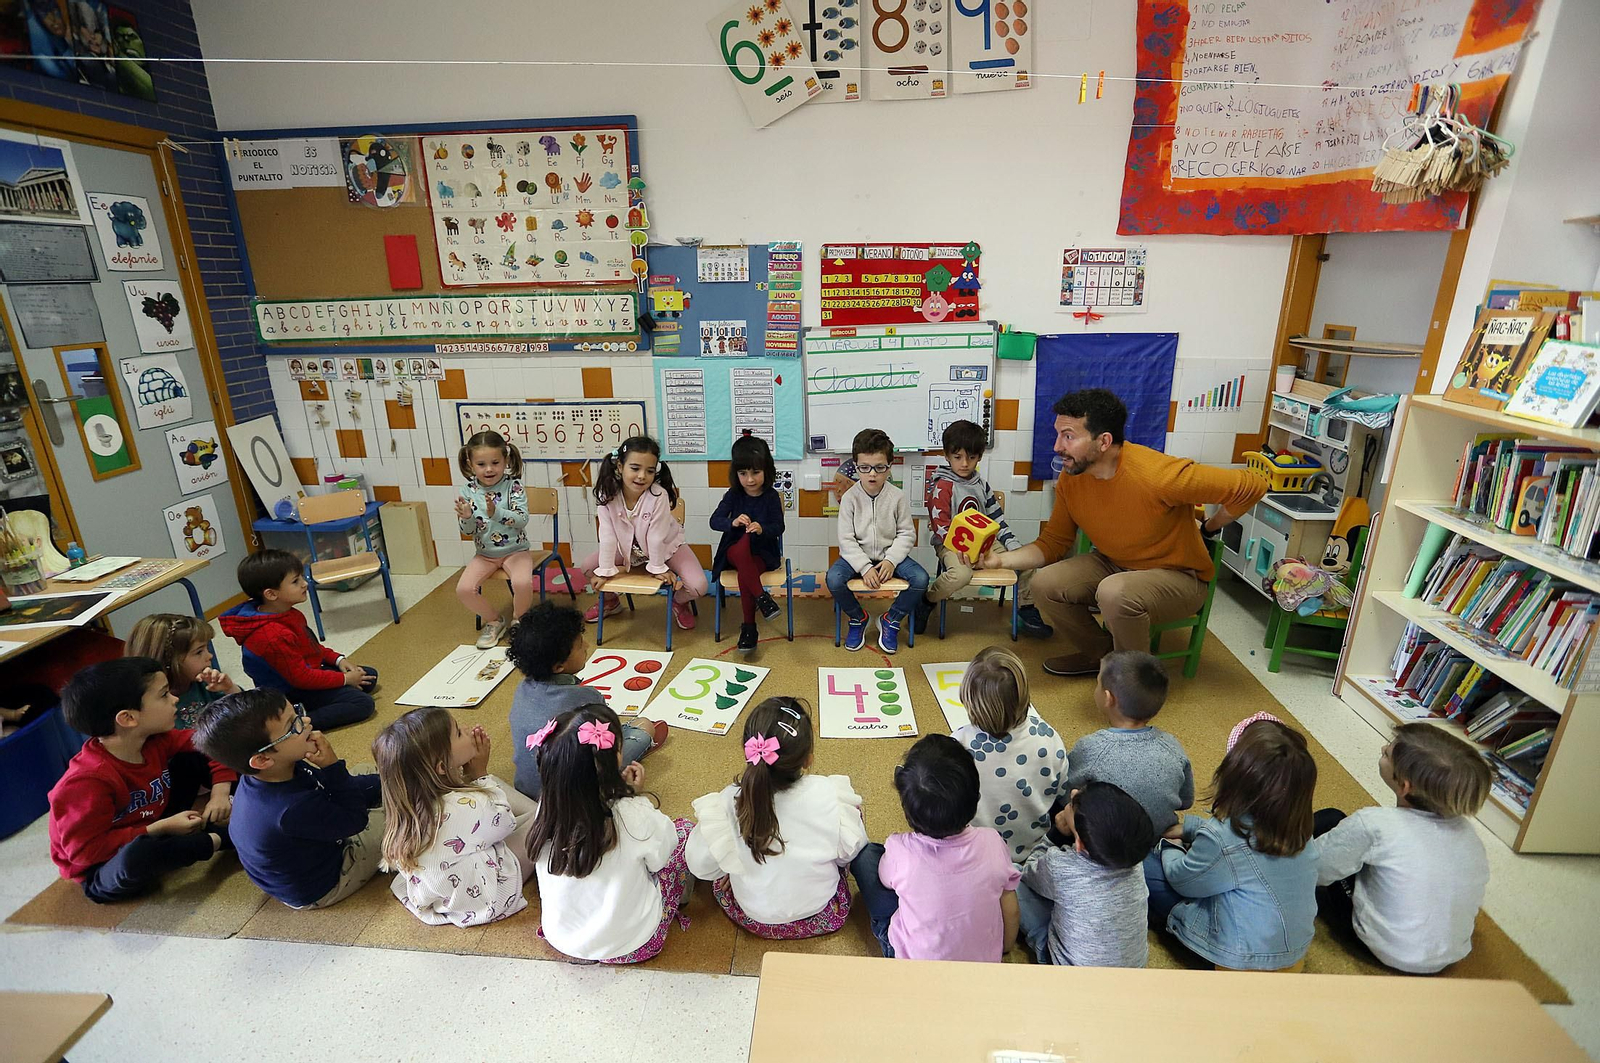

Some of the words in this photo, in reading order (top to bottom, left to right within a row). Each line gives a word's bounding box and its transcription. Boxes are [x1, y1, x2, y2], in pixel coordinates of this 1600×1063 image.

[1194, 5, 1198, 14] 1
[1201, 4, 1215, 14] NO
[872, 0, 910, 53] 8
[956, 0, 991, 50] 9
[1191, 21, 1196, 30] 2
[720, 20, 766, 84] 6
[896, 77, 919, 88] ocho
[776, 88, 794, 103] seis
[1176, 126, 1180, 134] 8
[1185, 128, 1200, 137] NO
[304, 147, 317, 158] ES
[1174, 144, 1178, 153] 9
[1185, 141, 1217, 158] NO
[1312, 162, 1319, 170] 20
[238, 174, 282, 182] PUNTALITO
[112, 252, 158, 268] elefante
[866, 249, 892, 259] VERANO
[902, 249, 924, 260] OTOÑO
[128, 285, 147, 296] Uu
[156, 339, 180, 348] uvas
[888, 338, 896, 347] 4
[912, 337, 948, 346] MAYO
[124, 363, 138, 374] Ii
[814, 364, 924, 392] Claudio
[154, 405, 174, 420] iglú
[172, 434, 186, 444] Aa
[499, 424, 510, 442] 3
[517, 424, 528, 442] 4
[536, 424, 548, 443] 5
[554, 424, 566, 443] 6
[573, 424, 584, 442] 7
[592, 424, 604, 442] 8
[610, 424, 620, 442] 9
[250, 436, 282, 487] 0
[191, 472, 218, 484] avión
[964, 514, 992, 528] 5
[447, 652, 485, 684] 1
[668, 665, 722, 701] 3
[828, 674, 868, 714] 4
[678, 712, 700, 722] tres
[848, 723, 888, 732] cuatro
